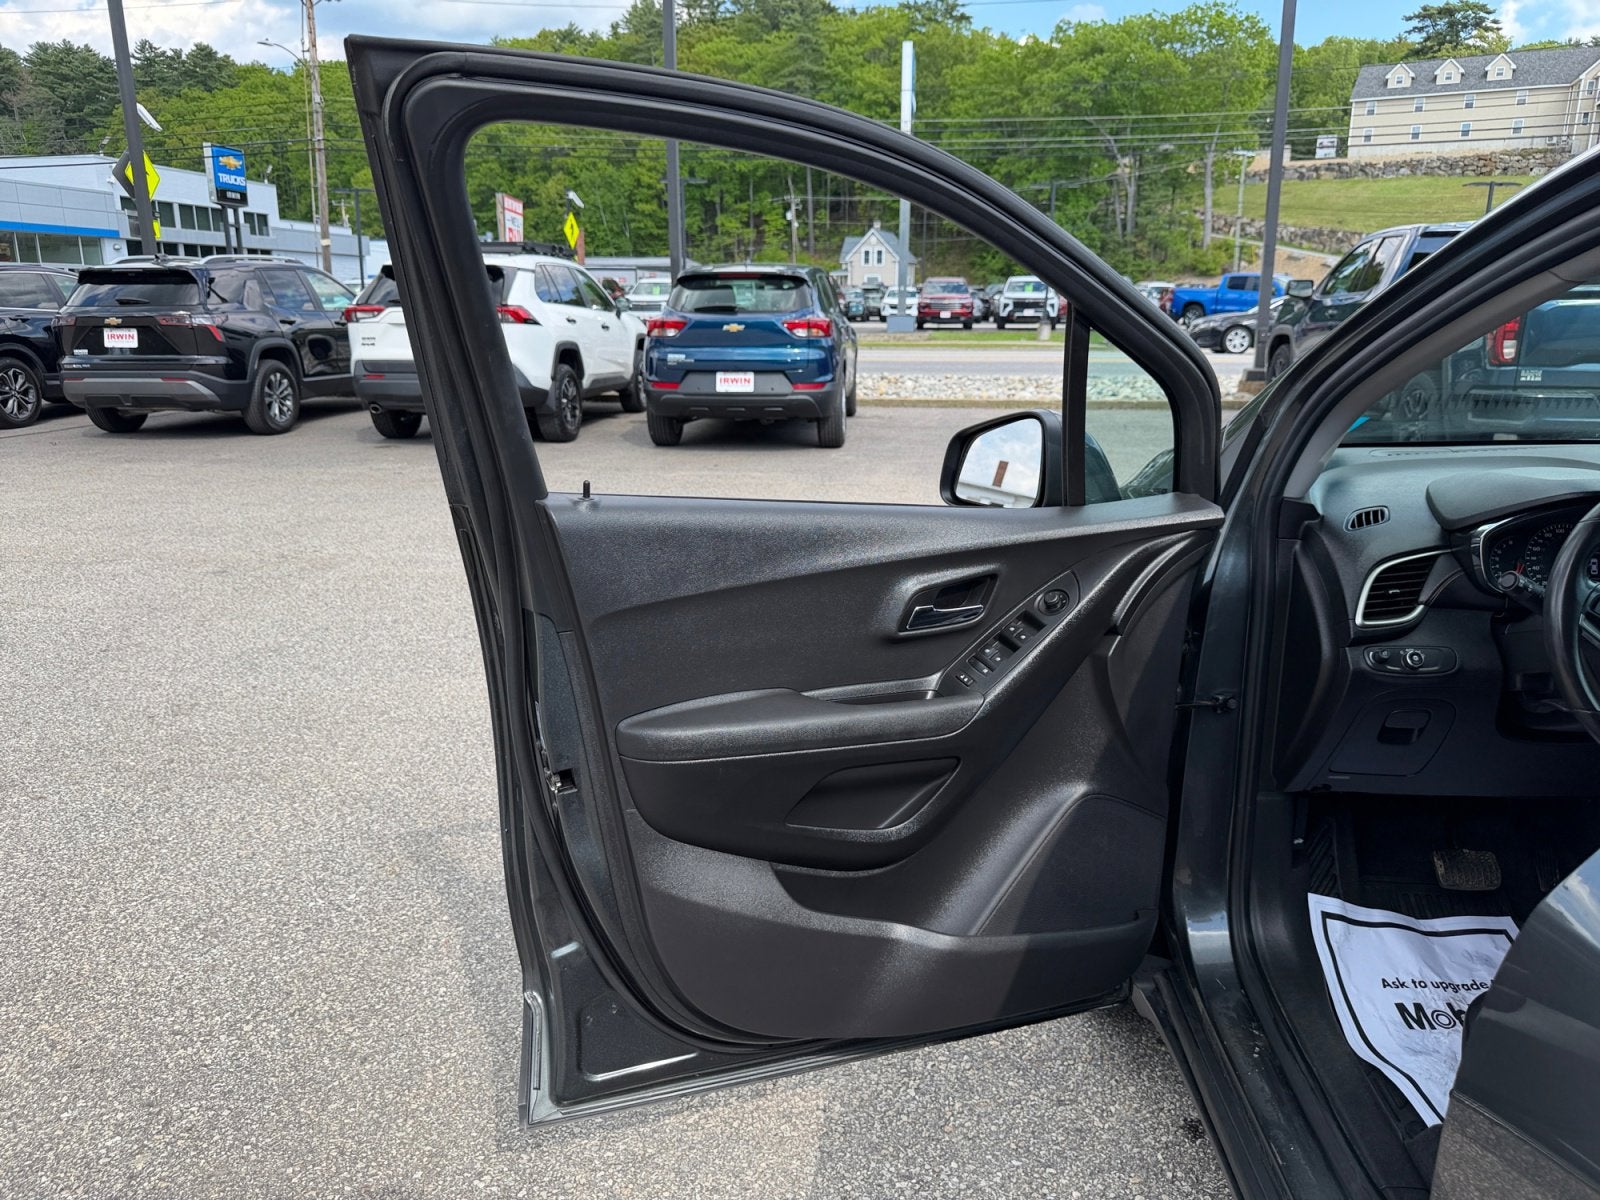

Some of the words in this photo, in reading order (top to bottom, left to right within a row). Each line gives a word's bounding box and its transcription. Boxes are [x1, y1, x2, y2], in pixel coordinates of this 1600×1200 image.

[218, 173, 246, 186] TRUCKS
[107, 333, 135, 341] IRWIN
[719, 377, 751, 385] IRWIN
[1381, 977, 1410, 989] Ask
[1411, 978, 1428, 989] to
[1430, 979, 1489, 994] upgrade
[1394, 1002, 1470, 1029] Mob
